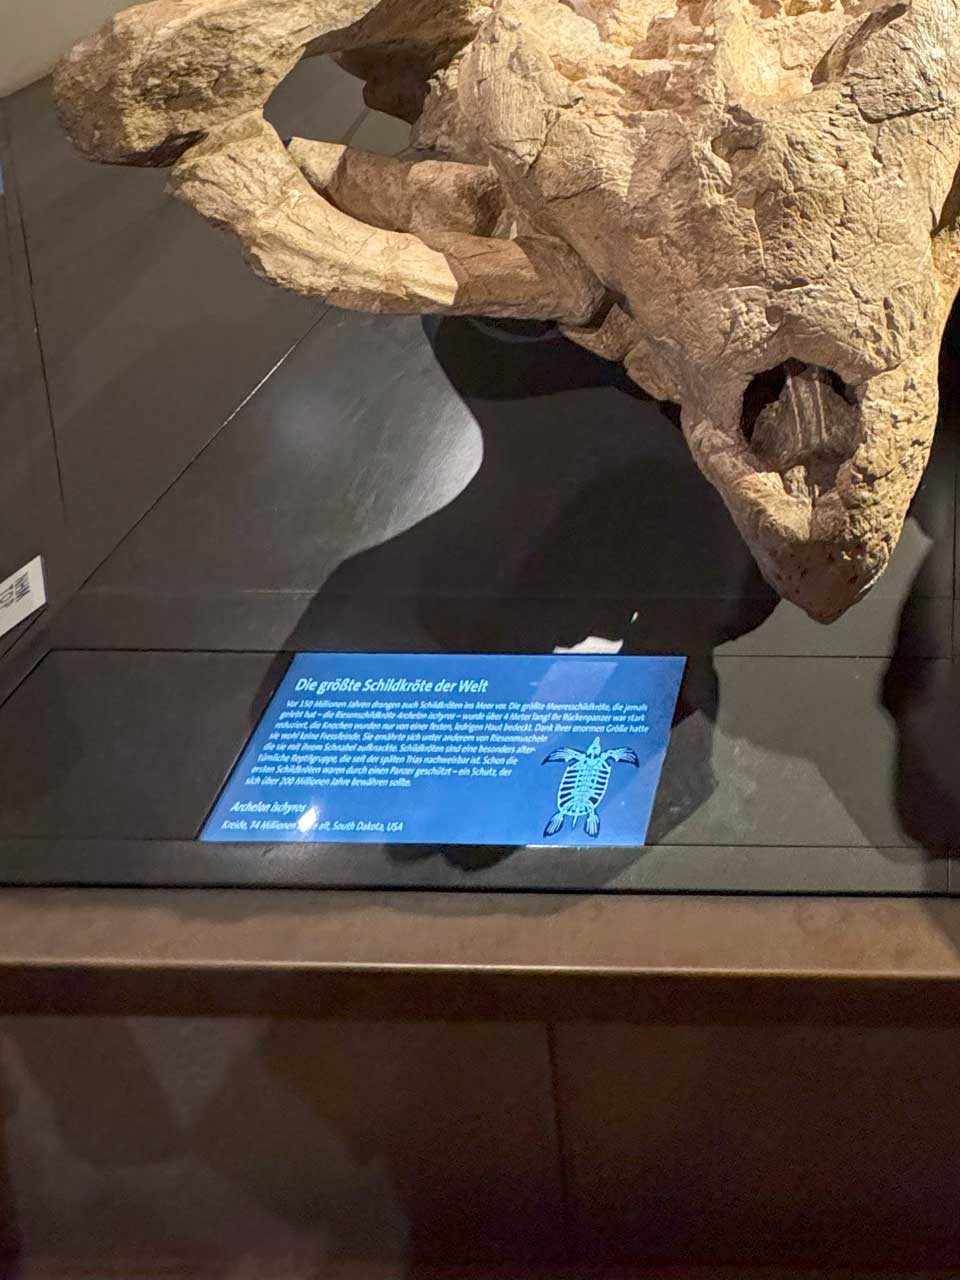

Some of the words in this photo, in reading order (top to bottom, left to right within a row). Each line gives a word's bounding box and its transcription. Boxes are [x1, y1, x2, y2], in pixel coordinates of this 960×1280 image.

[295, 678, 315, 691] Die
[316, 678, 361, 694] größte
[362, 678, 433, 692] Schildkröte
[434, 679, 457, 692] der
[458, 680, 489, 692] Welt
[230, 801, 269, 812] Archelon
[270, 801, 306, 815] ischyros
[221, 821, 247, 831] Kreide,
[249, 821, 260, 830] 74
[260, 821, 296, 831] Millionen
[332, 821, 355, 831] South
[356, 821, 385, 832] Dakota,
[387, 822, 403, 831] USA
